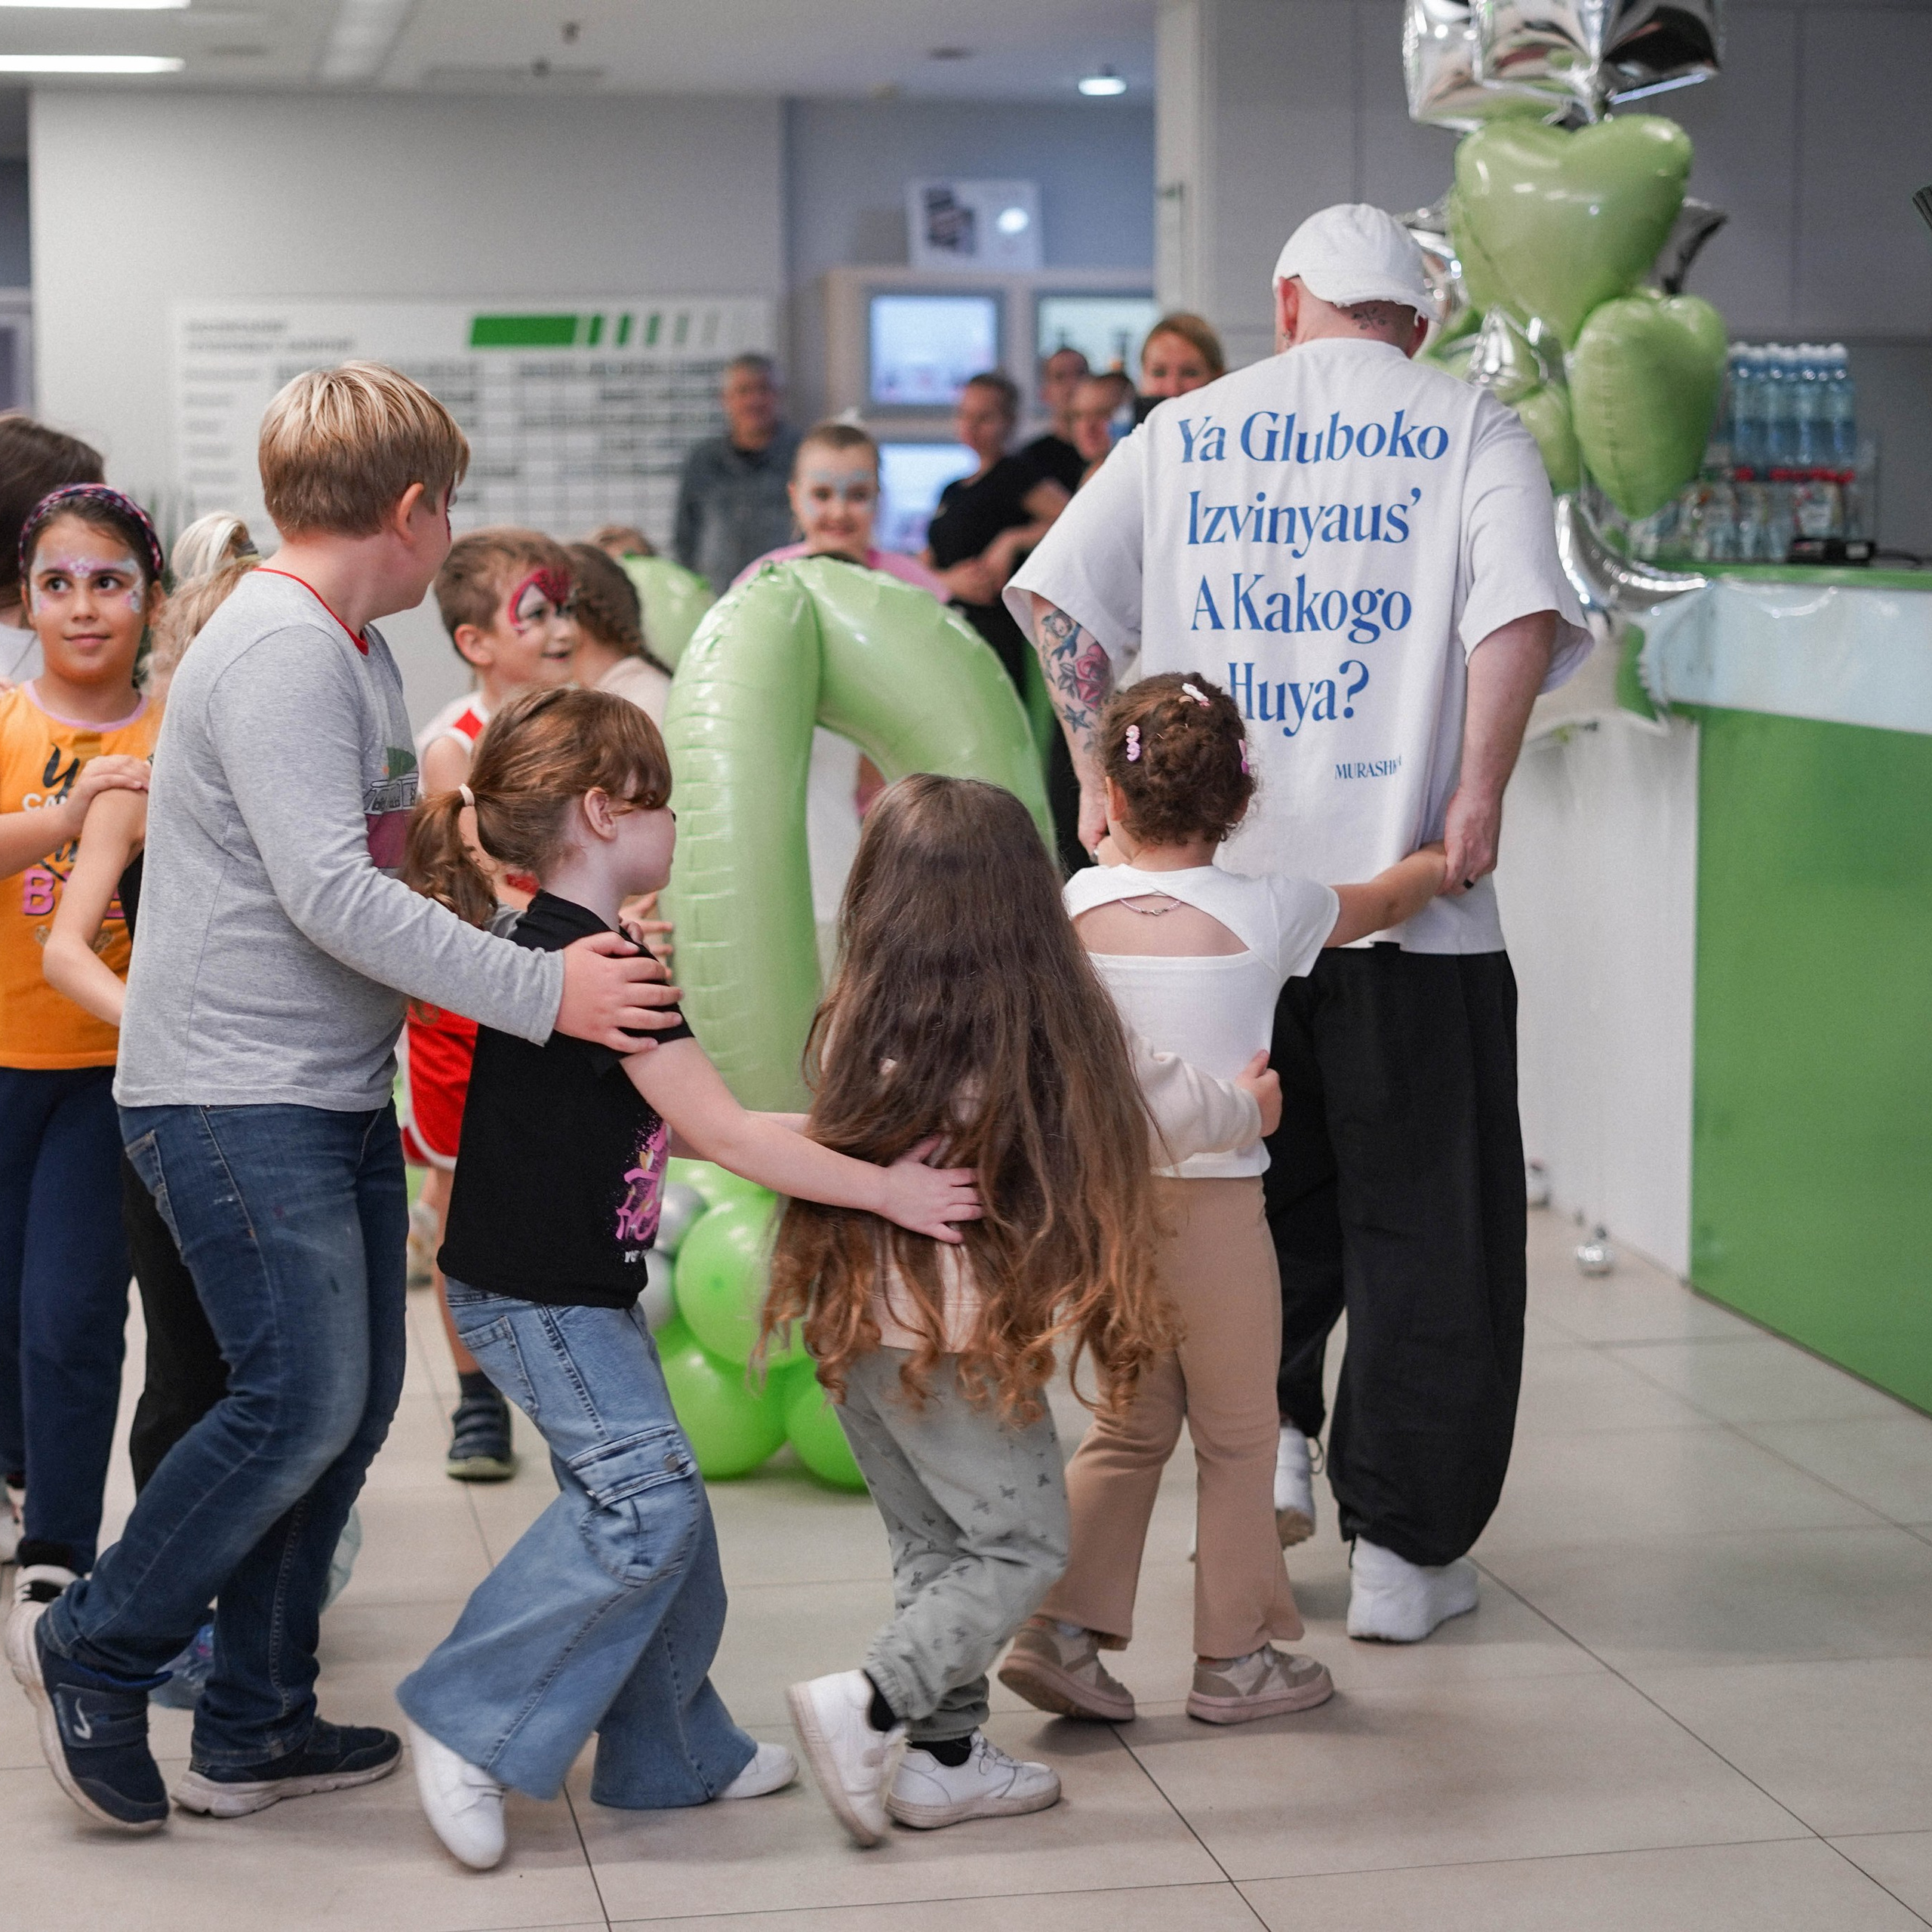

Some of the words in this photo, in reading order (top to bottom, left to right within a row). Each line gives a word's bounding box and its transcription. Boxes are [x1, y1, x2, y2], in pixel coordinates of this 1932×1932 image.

[1177, 416, 1226, 463] Ya
[1240, 409, 1449, 463] Gluboko
[1190, 574, 1226, 630] A
[1232, 572, 1412, 645] Kakogo
[1228, 659, 1370, 737] Huya?
